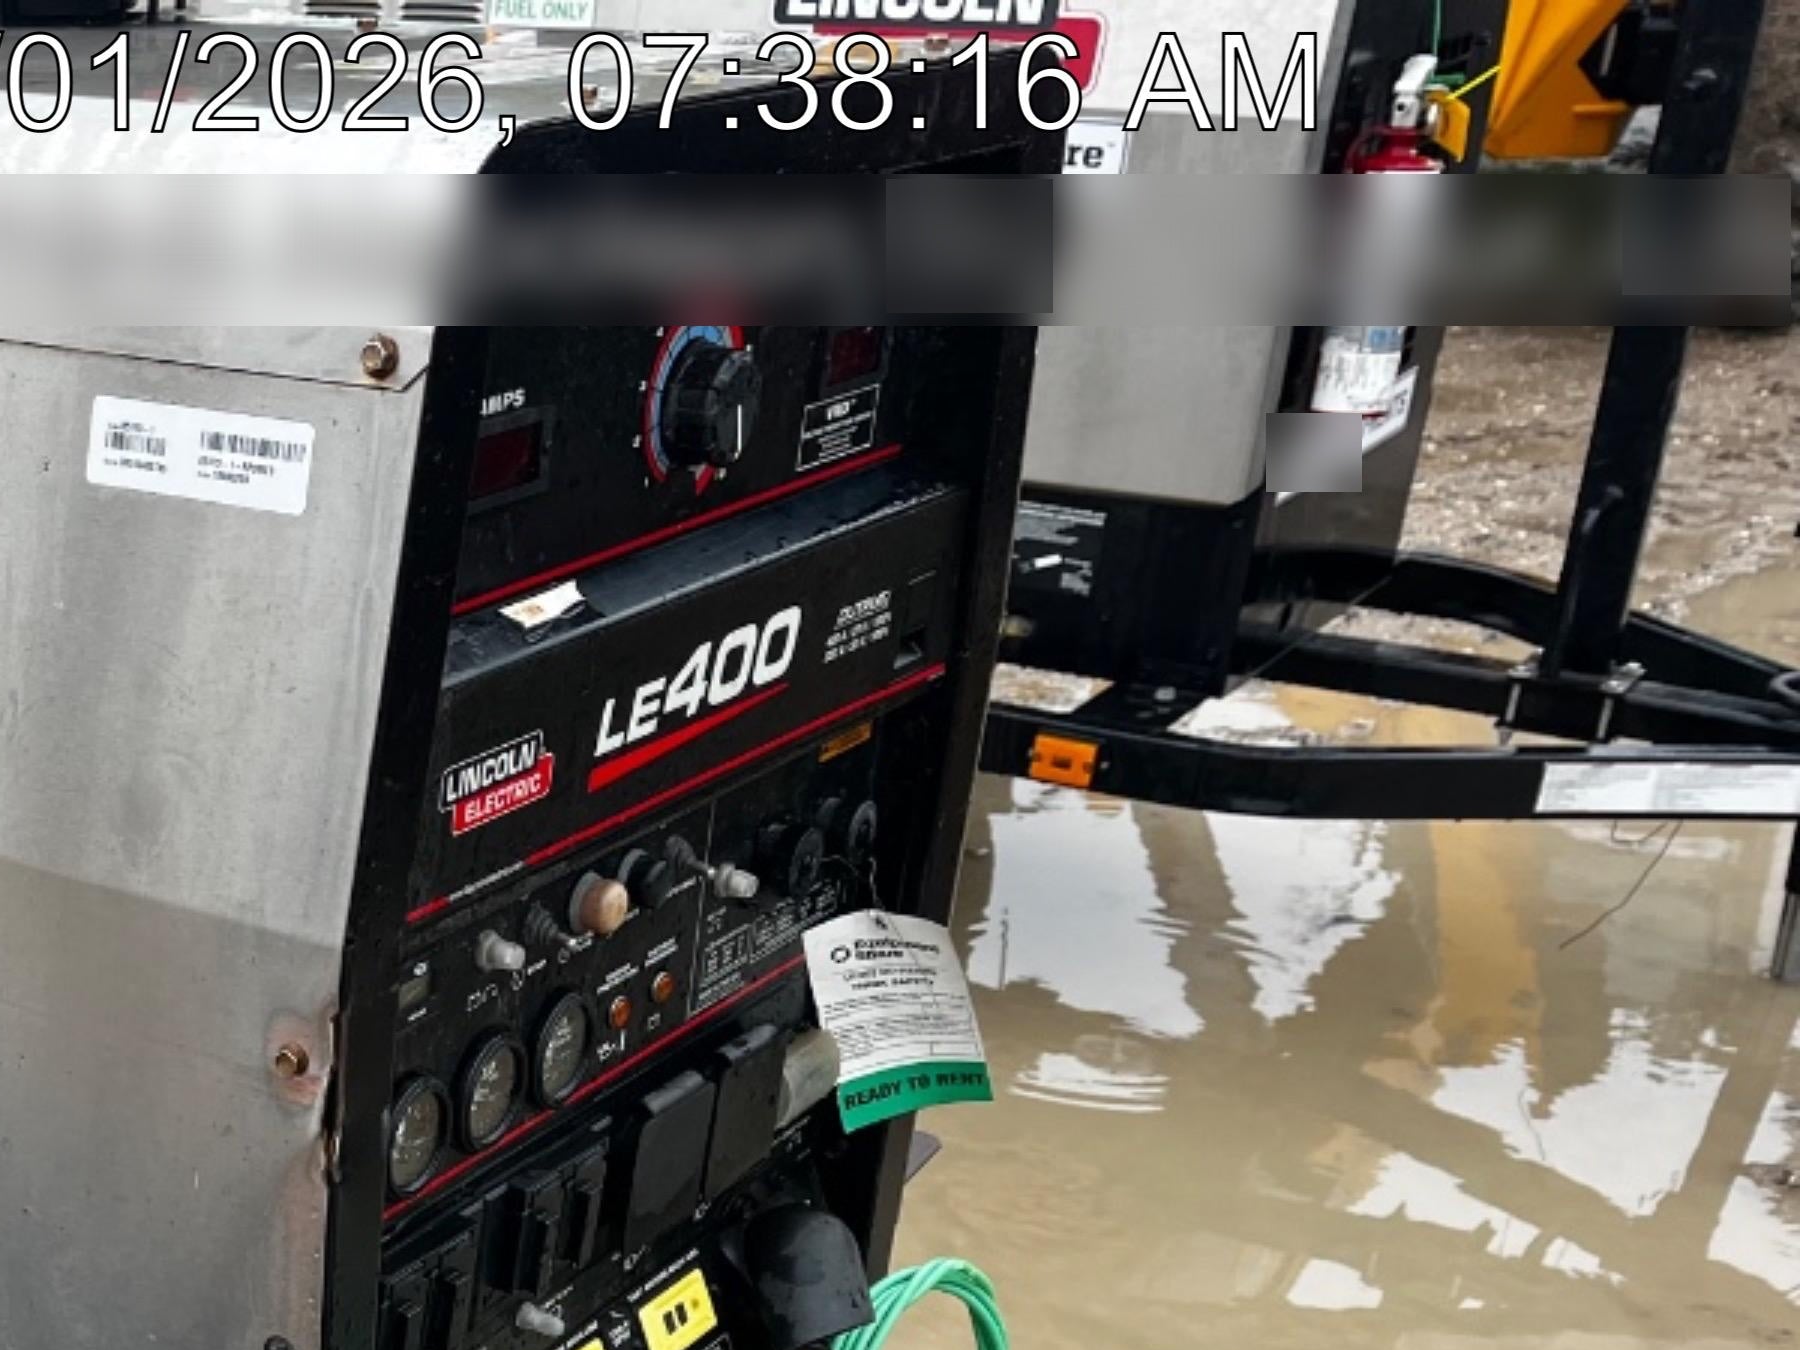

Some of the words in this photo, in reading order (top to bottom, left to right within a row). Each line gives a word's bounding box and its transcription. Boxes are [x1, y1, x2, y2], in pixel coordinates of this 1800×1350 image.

[543, 1, 588, 20] ONLY
[593, 605, 803, 758] LE400
[446, 740, 538, 803] LINCOLN
[463, 773, 542, 823] ELECTRIC
[844, 1079, 901, 1111] READY
[907, 1075, 932, 1092] TO
[936, 1072, 984, 1087] RENT
